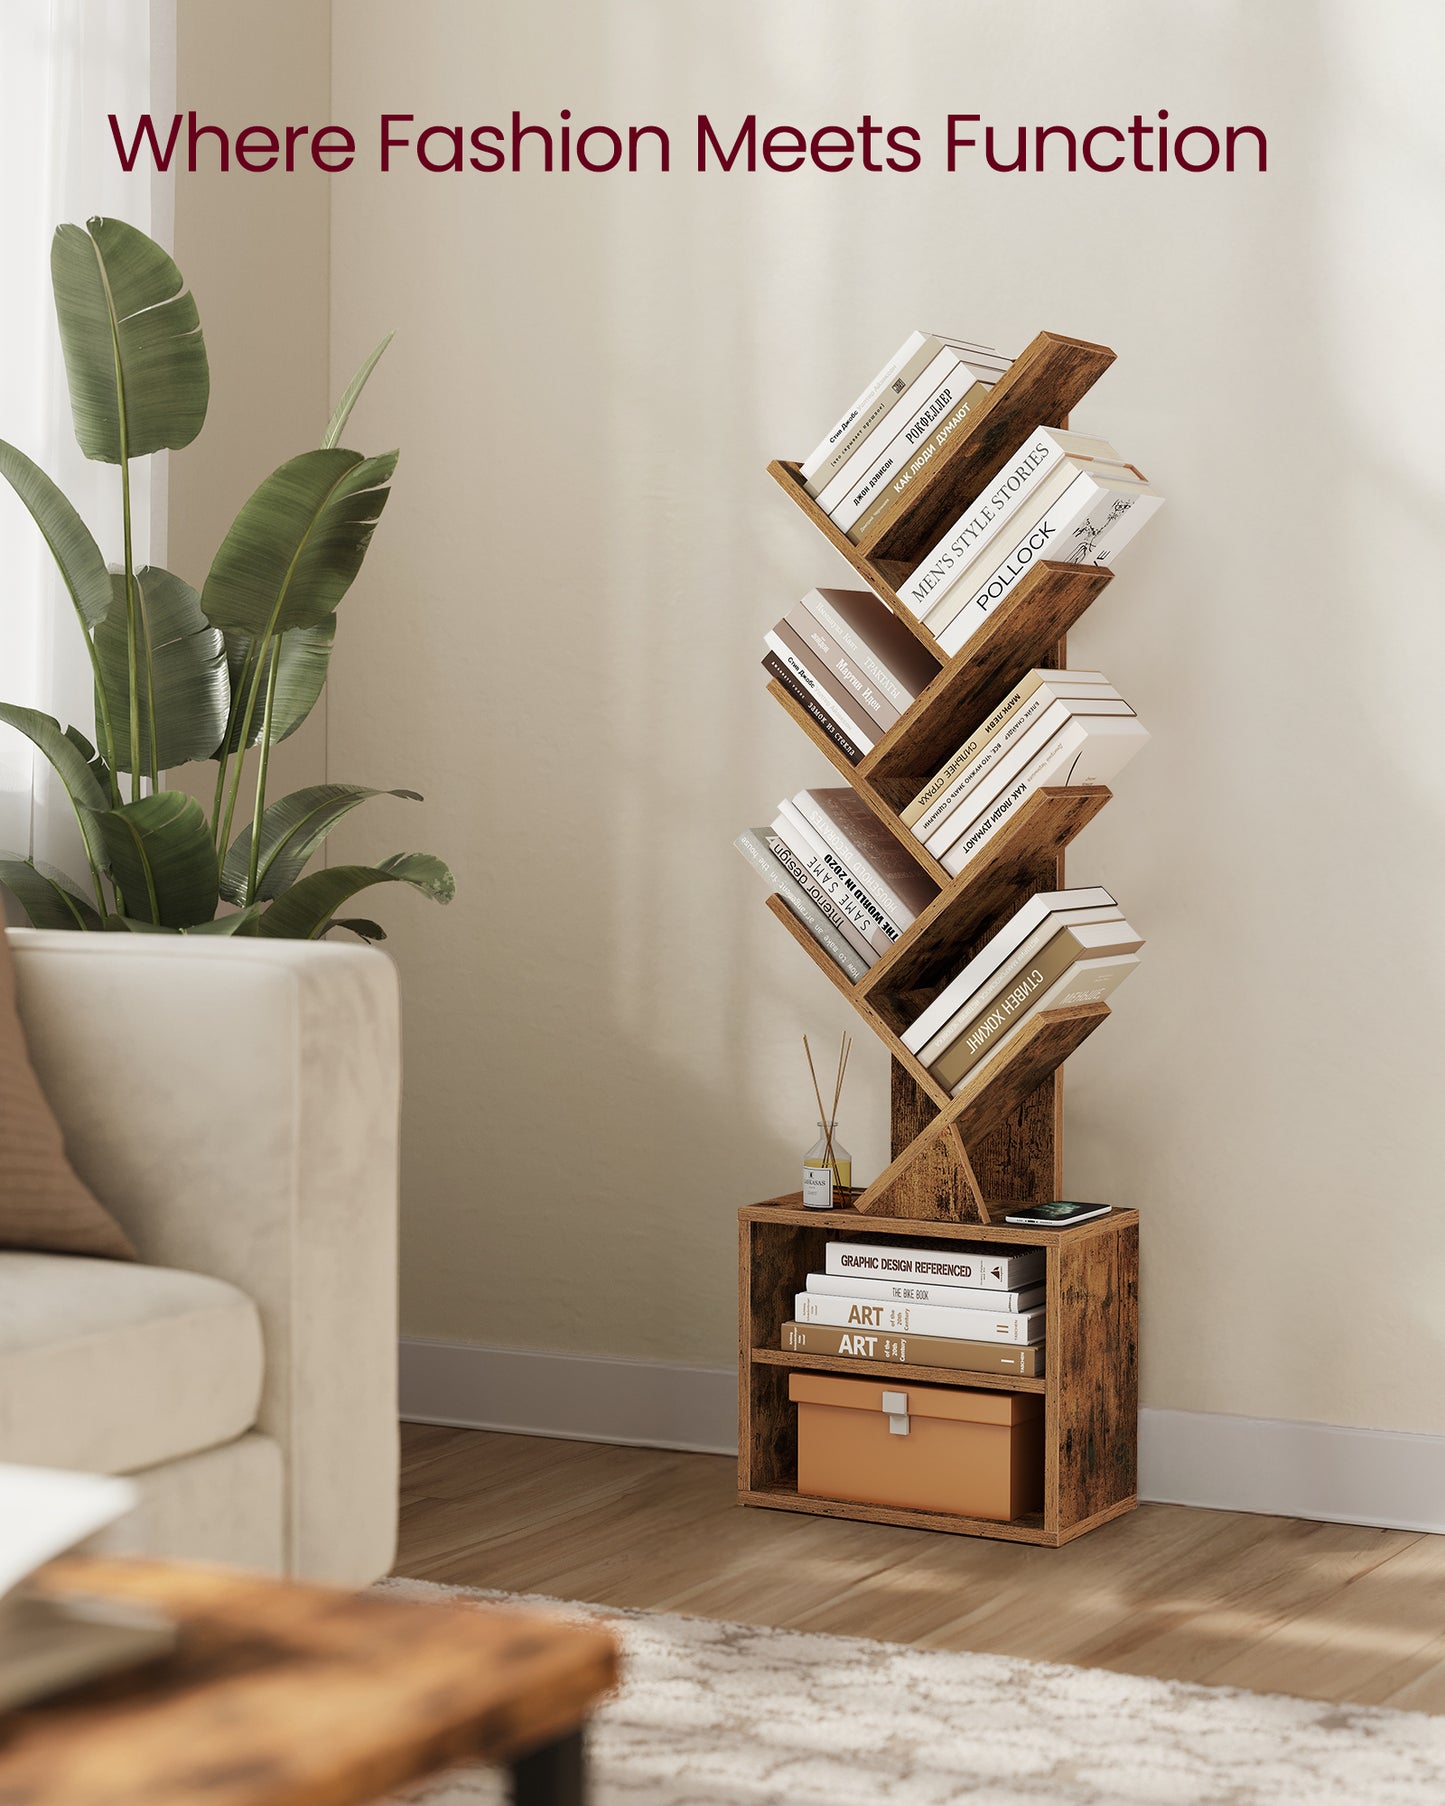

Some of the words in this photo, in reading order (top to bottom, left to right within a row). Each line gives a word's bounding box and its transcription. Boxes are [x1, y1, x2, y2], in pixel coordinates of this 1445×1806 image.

[904, 388, 954, 444] РОКФЕЛЛЕР
[828, 429, 842, 443] Стив
[892, 471, 912, 492] КАК
[908, 443, 936, 474] ЛЮДИ
[933, 402, 972, 445] ДУМАЮТ
[949, 505, 996, 558] STYLE
[989, 441, 1050, 511] STORIES
[975, 520, 1056, 611] POLLOCK
[786, 656, 801, 671] Стив
[834, 658, 864, 691] Мартин
[860, 687, 883, 712] Иден
[1001, 693, 1021, 714] МАРК
[807, 702, 827, 724] замок
[825, 722, 835, 733] из
[833, 732, 855, 756] стекла
[983, 711, 1004, 733] ЛЕВИ
[942, 740, 978, 778] СИЛЬНЕЕ
[980, 753, 991, 765] ЧТО
[963, 763, 982, 783] НУЖНО
[917, 776, 945, 806] СТРАХА
[950, 782, 965, 798] ЗНАТЬ
[1010, 782, 1027, 800] КАК
[989, 797, 1013, 822] ЛЮДИ
[808, 809, 853, 860] DECORATES
[960, 819, 993, 854] ДУМАЮТ
[771, 841, 808, 885] design
[805, 856, 839, 893] SAME
[822, 853, 847, 880] 2020
[843, 877, 856, 891] IN
[851, 861, 897, 912] HOUSEHOLD
[805, 883, 845, 928] Interior
[837, 893, 871, 931] SAME
[852, 888, 885, 924] WORLD
[813, 923, 823, 934] an
[880, 921, 900, 942] THE
[821, 934, 839, 953] make
[837, 952, 847, 963] to
[845, 962, 860, 978] How
[999, 968, 1045, 1014] СТИВЕН
[961, 1009, 1006, 1054] ХОКИНГ
[840, 1254, 879, 1270] GRAPHIC
[881, 1258, 913, 1273] DESIGN
[915, 1261, 972, 1278] REFERENCED
[892, 1287, 901, 1298] THE
[903, 1289, 915, 1300] BIKE
[916, 1289, 929, 1301] BOOK
[848, 1304, 884, 1326] ART
[838, 1334, 878, 1357] ART
